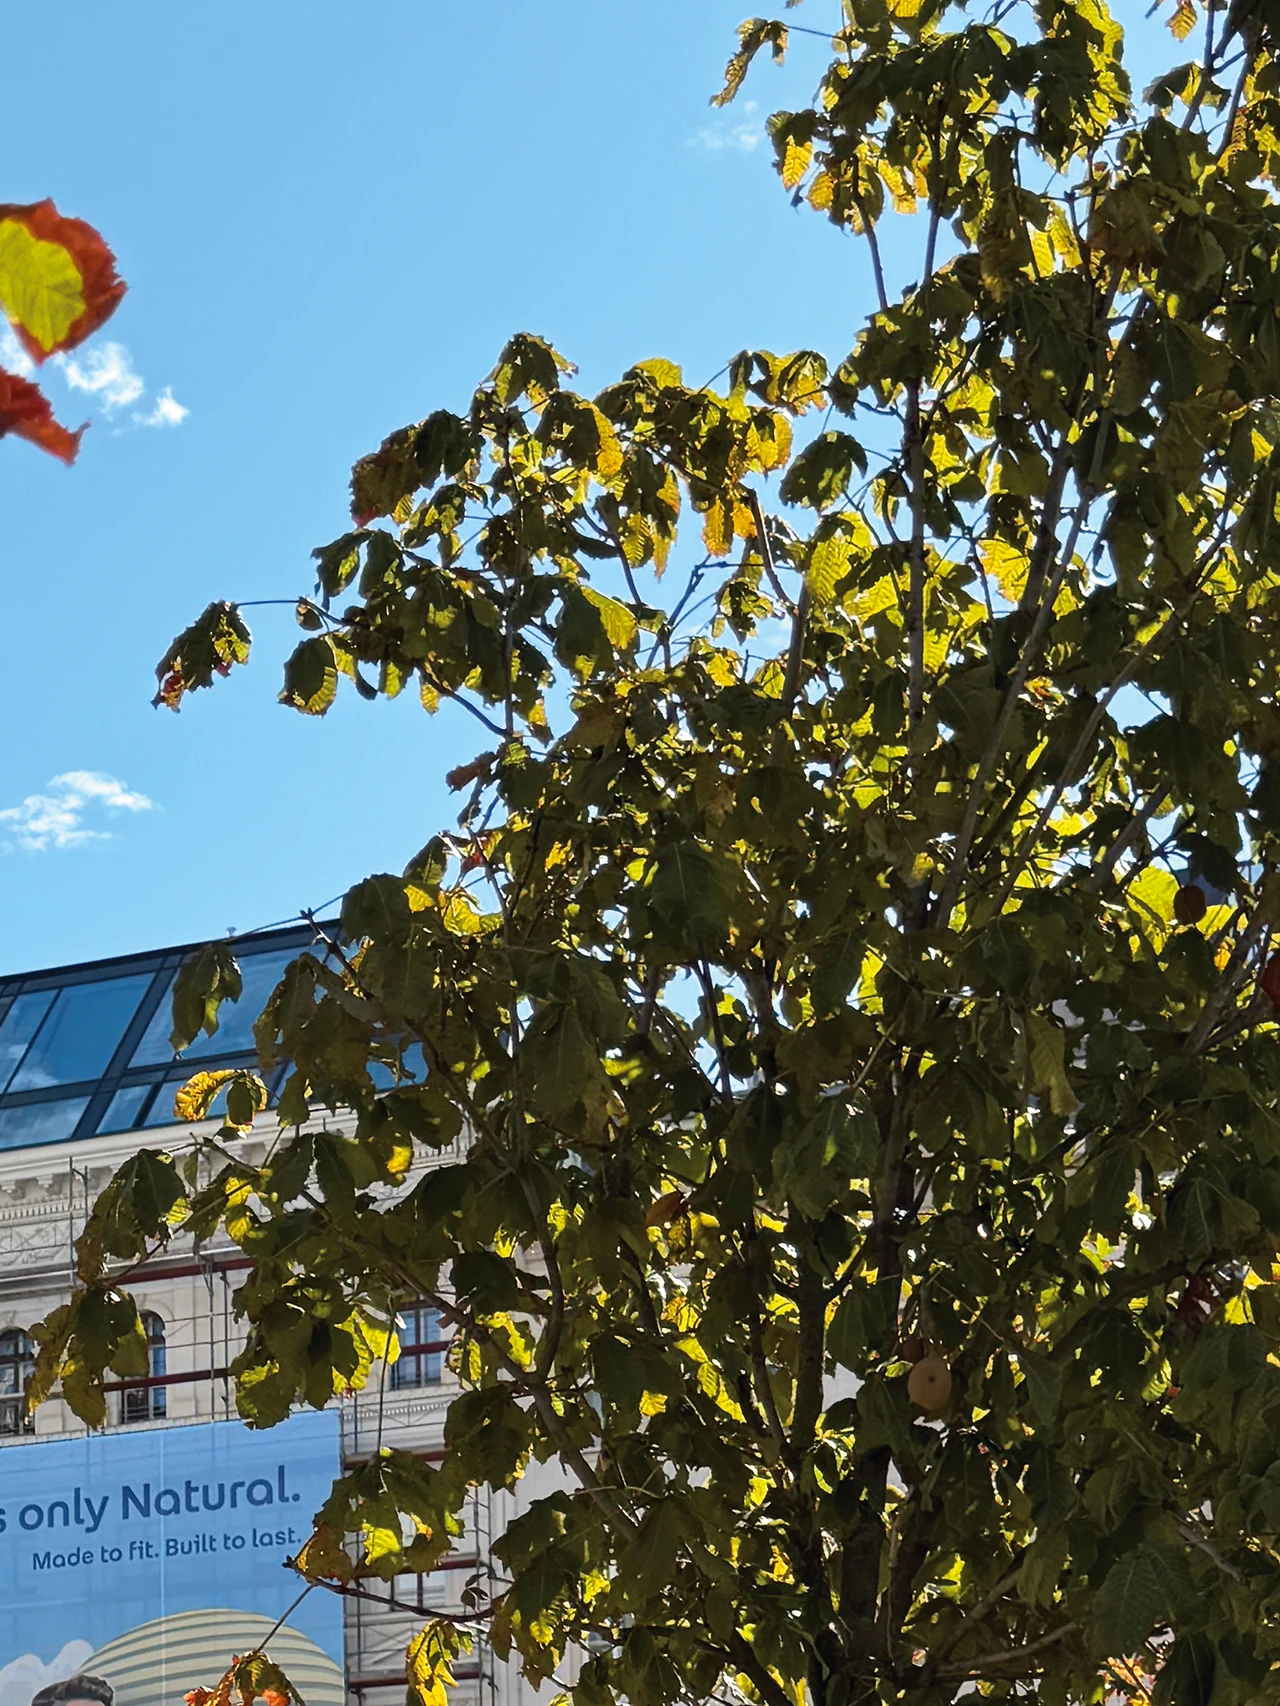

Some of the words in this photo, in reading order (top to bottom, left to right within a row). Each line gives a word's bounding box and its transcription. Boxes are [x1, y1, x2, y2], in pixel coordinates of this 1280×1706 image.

[19, 1487, 109, 1533] only
[122, 1465, 301, 1519] Natural.
[33, 1547, 94, 1571] Made
[101, 1545, 123, 1563] to
[129, 1541, 159, 1560] fit.
[166, 1533, 217, 1557] Built
[223, 1533, 246, 1550] to
[252, 1527, 302, 1547] last.
